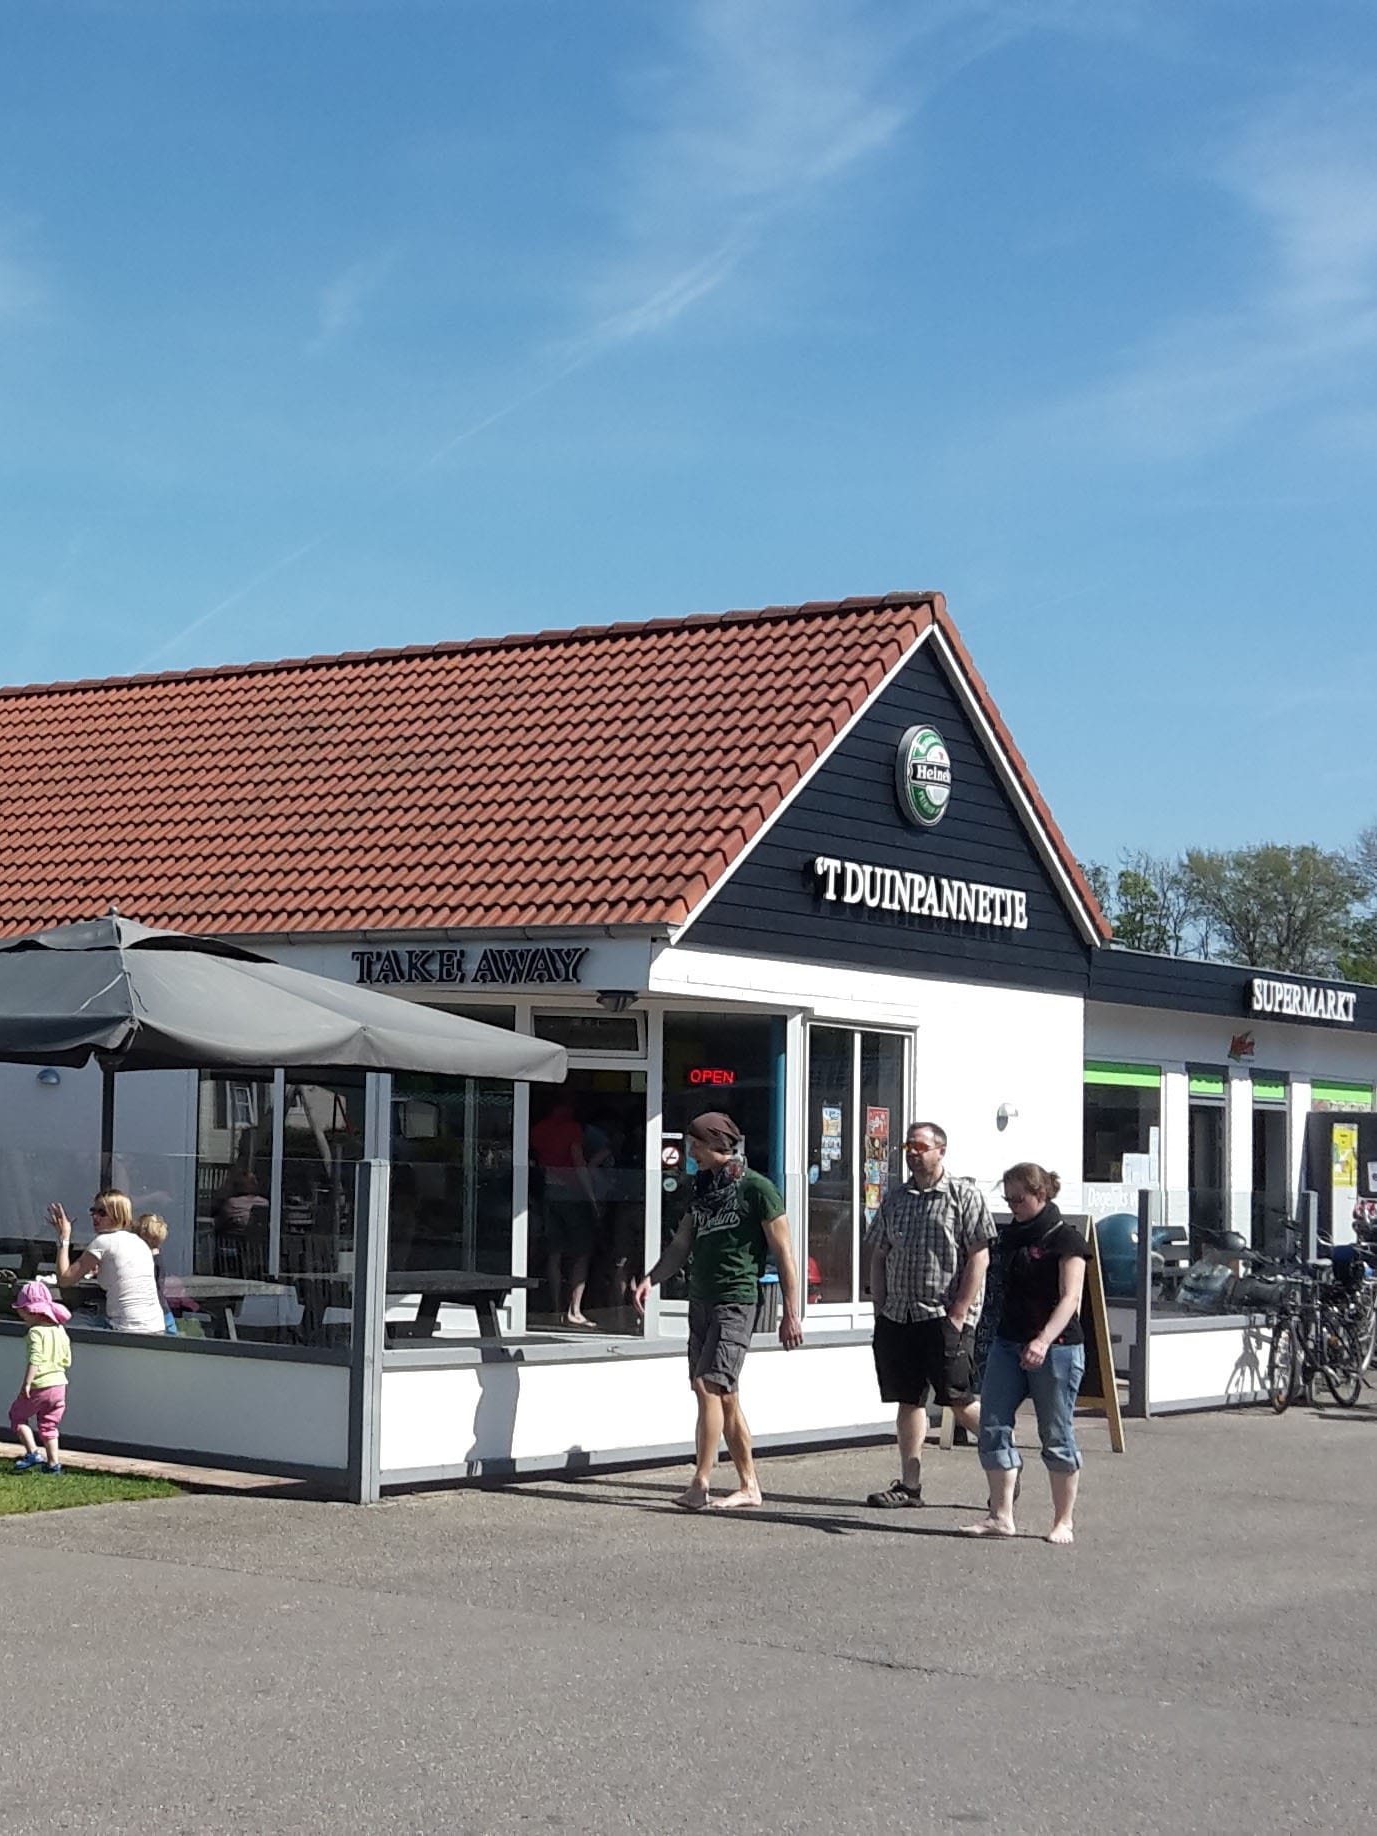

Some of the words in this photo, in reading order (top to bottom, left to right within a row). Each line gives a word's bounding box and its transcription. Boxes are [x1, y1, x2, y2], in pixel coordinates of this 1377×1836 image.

[843, 861, 1028, 930] DUINPANNETJE
[352, 949, 465, 984] TAKE
[471, 947, 590, 984] AWAY
[1252, 978, 1357, 1022] SUPERMARKT
[689, 1068, 735, 1085] OPEN
